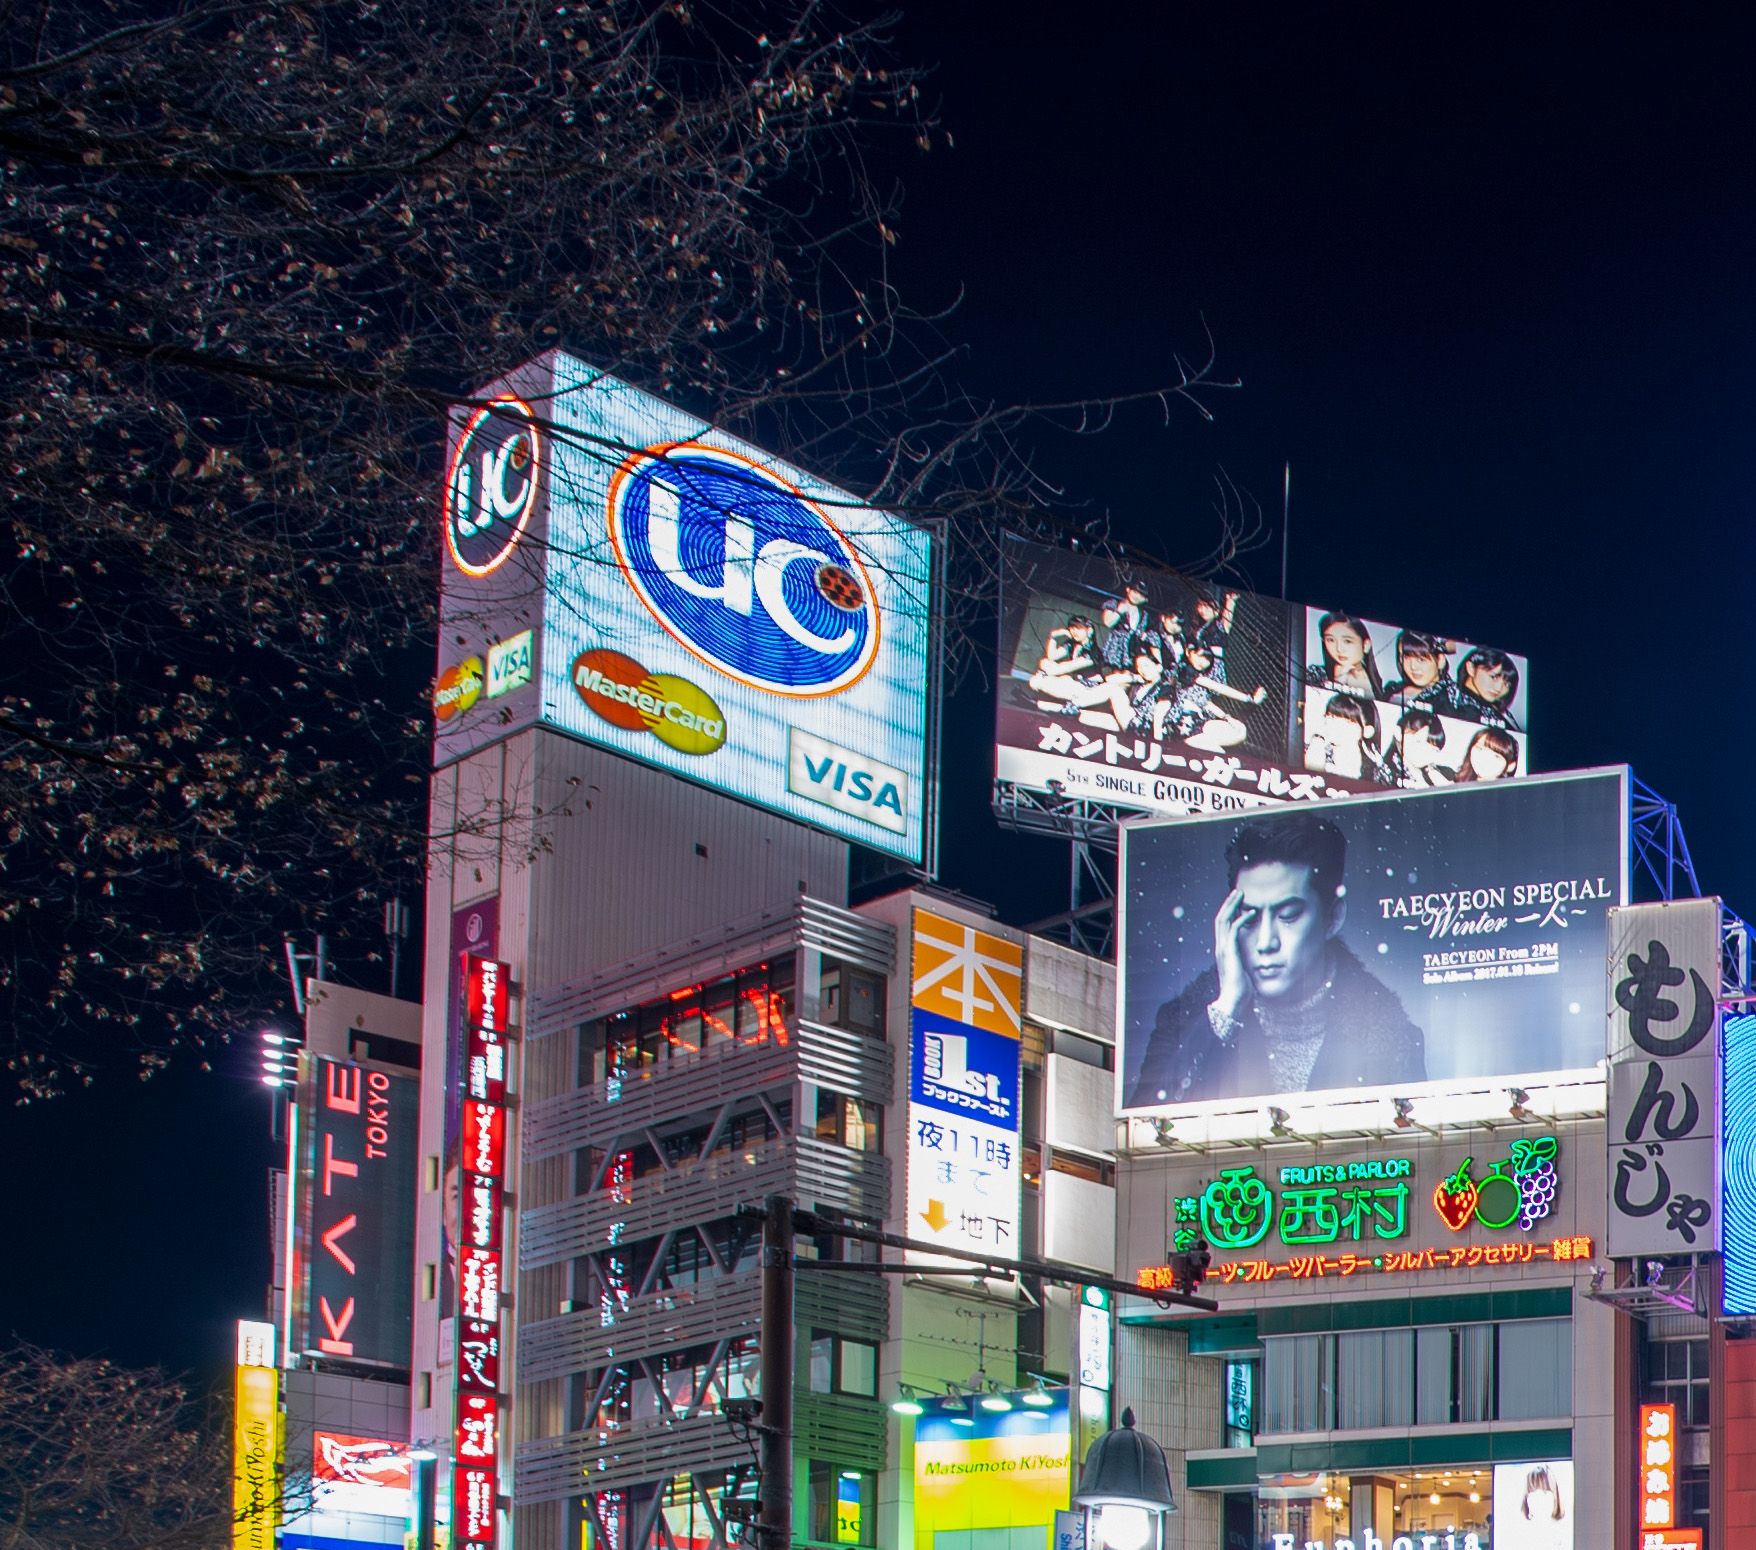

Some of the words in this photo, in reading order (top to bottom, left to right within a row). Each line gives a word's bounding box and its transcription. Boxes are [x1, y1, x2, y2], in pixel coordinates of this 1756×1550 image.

[648, 478, 864, 654] UC
[490, 652, 530, 681] VISA
[576, 666, 724, 741] MasterCard
[803, 752, 904, 817] VISA
[1038, 722, 1326, 800] カントリー・ガールズ
[1095, 774, 1146, 796] SINGLE
[1154, 779, 1205, 806] GOOD
[1379, 888, 1505, 919] TAECYEON
[1513, 878, 1611, 907] SPECIAL
[1423, 948, 1495, 967] TAECYEON
[1499, 946, 1530, 960] From
[1532, 943, 1559, 958] 2PM
[367, 1072, 390, 1159] TOKYO
[921, 1083, 1010, 1119] ブックファースト
[1614, 939, 1714, 1246] もんじゃ
[960, 1208, 1010, 1244] 地下
[1280, 1182, 1410, 1245] 西村
[924, 1459, 1017, 1477] Matsumoto
[1019, 1456, 1070, 1473] KiYos
